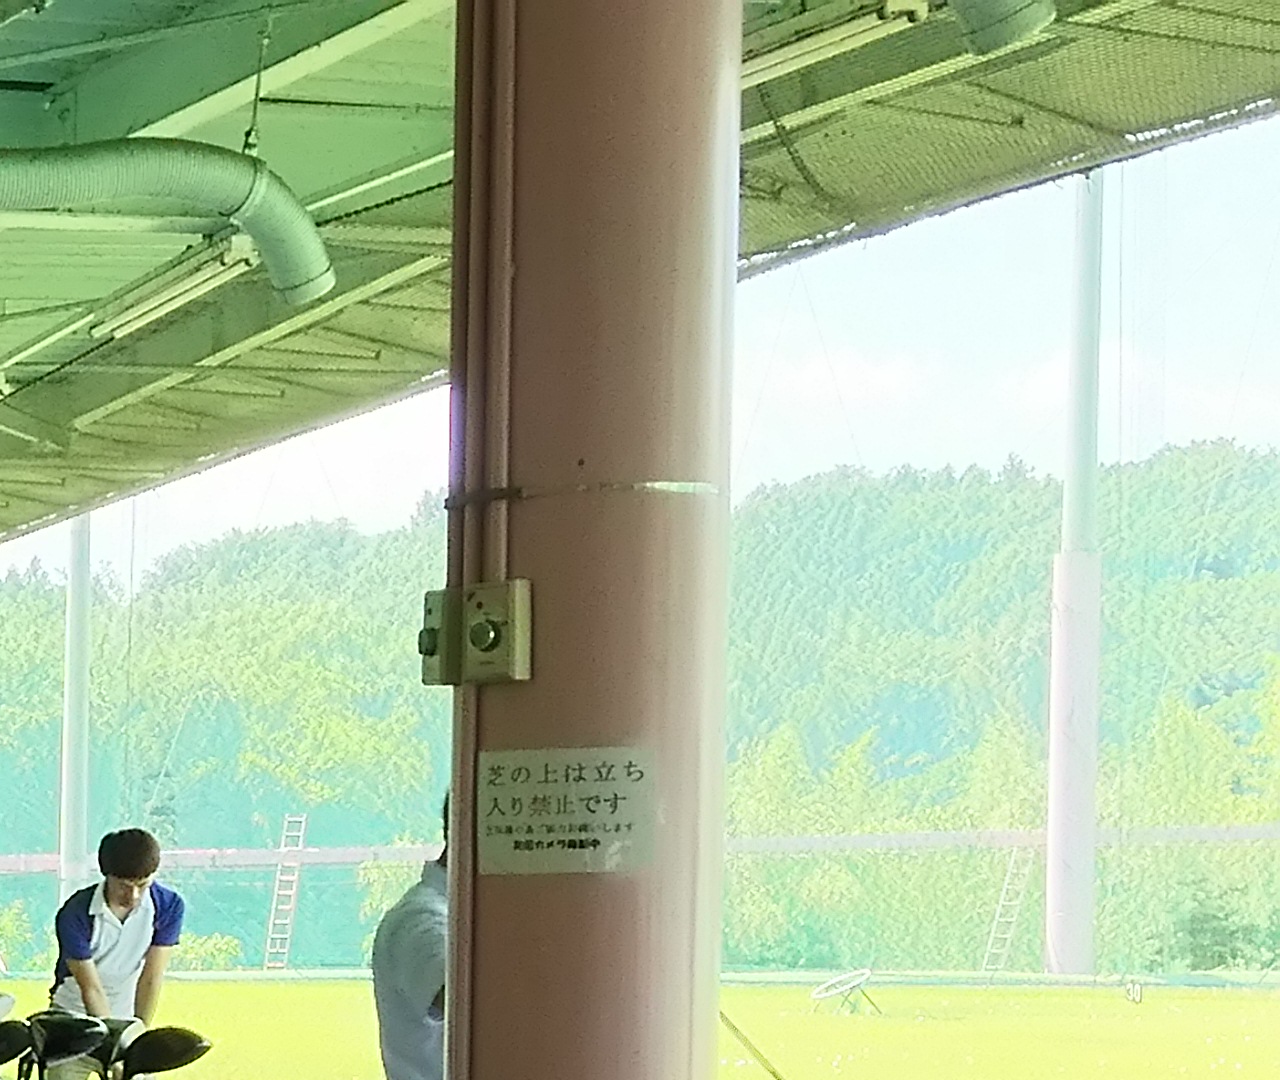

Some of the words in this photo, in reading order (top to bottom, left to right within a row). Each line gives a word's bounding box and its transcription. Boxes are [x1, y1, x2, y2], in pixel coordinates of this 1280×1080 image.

[487, 760, 644, 786] 芝の上は立ち
[486, 793, 627, 817] 入り禁止です
